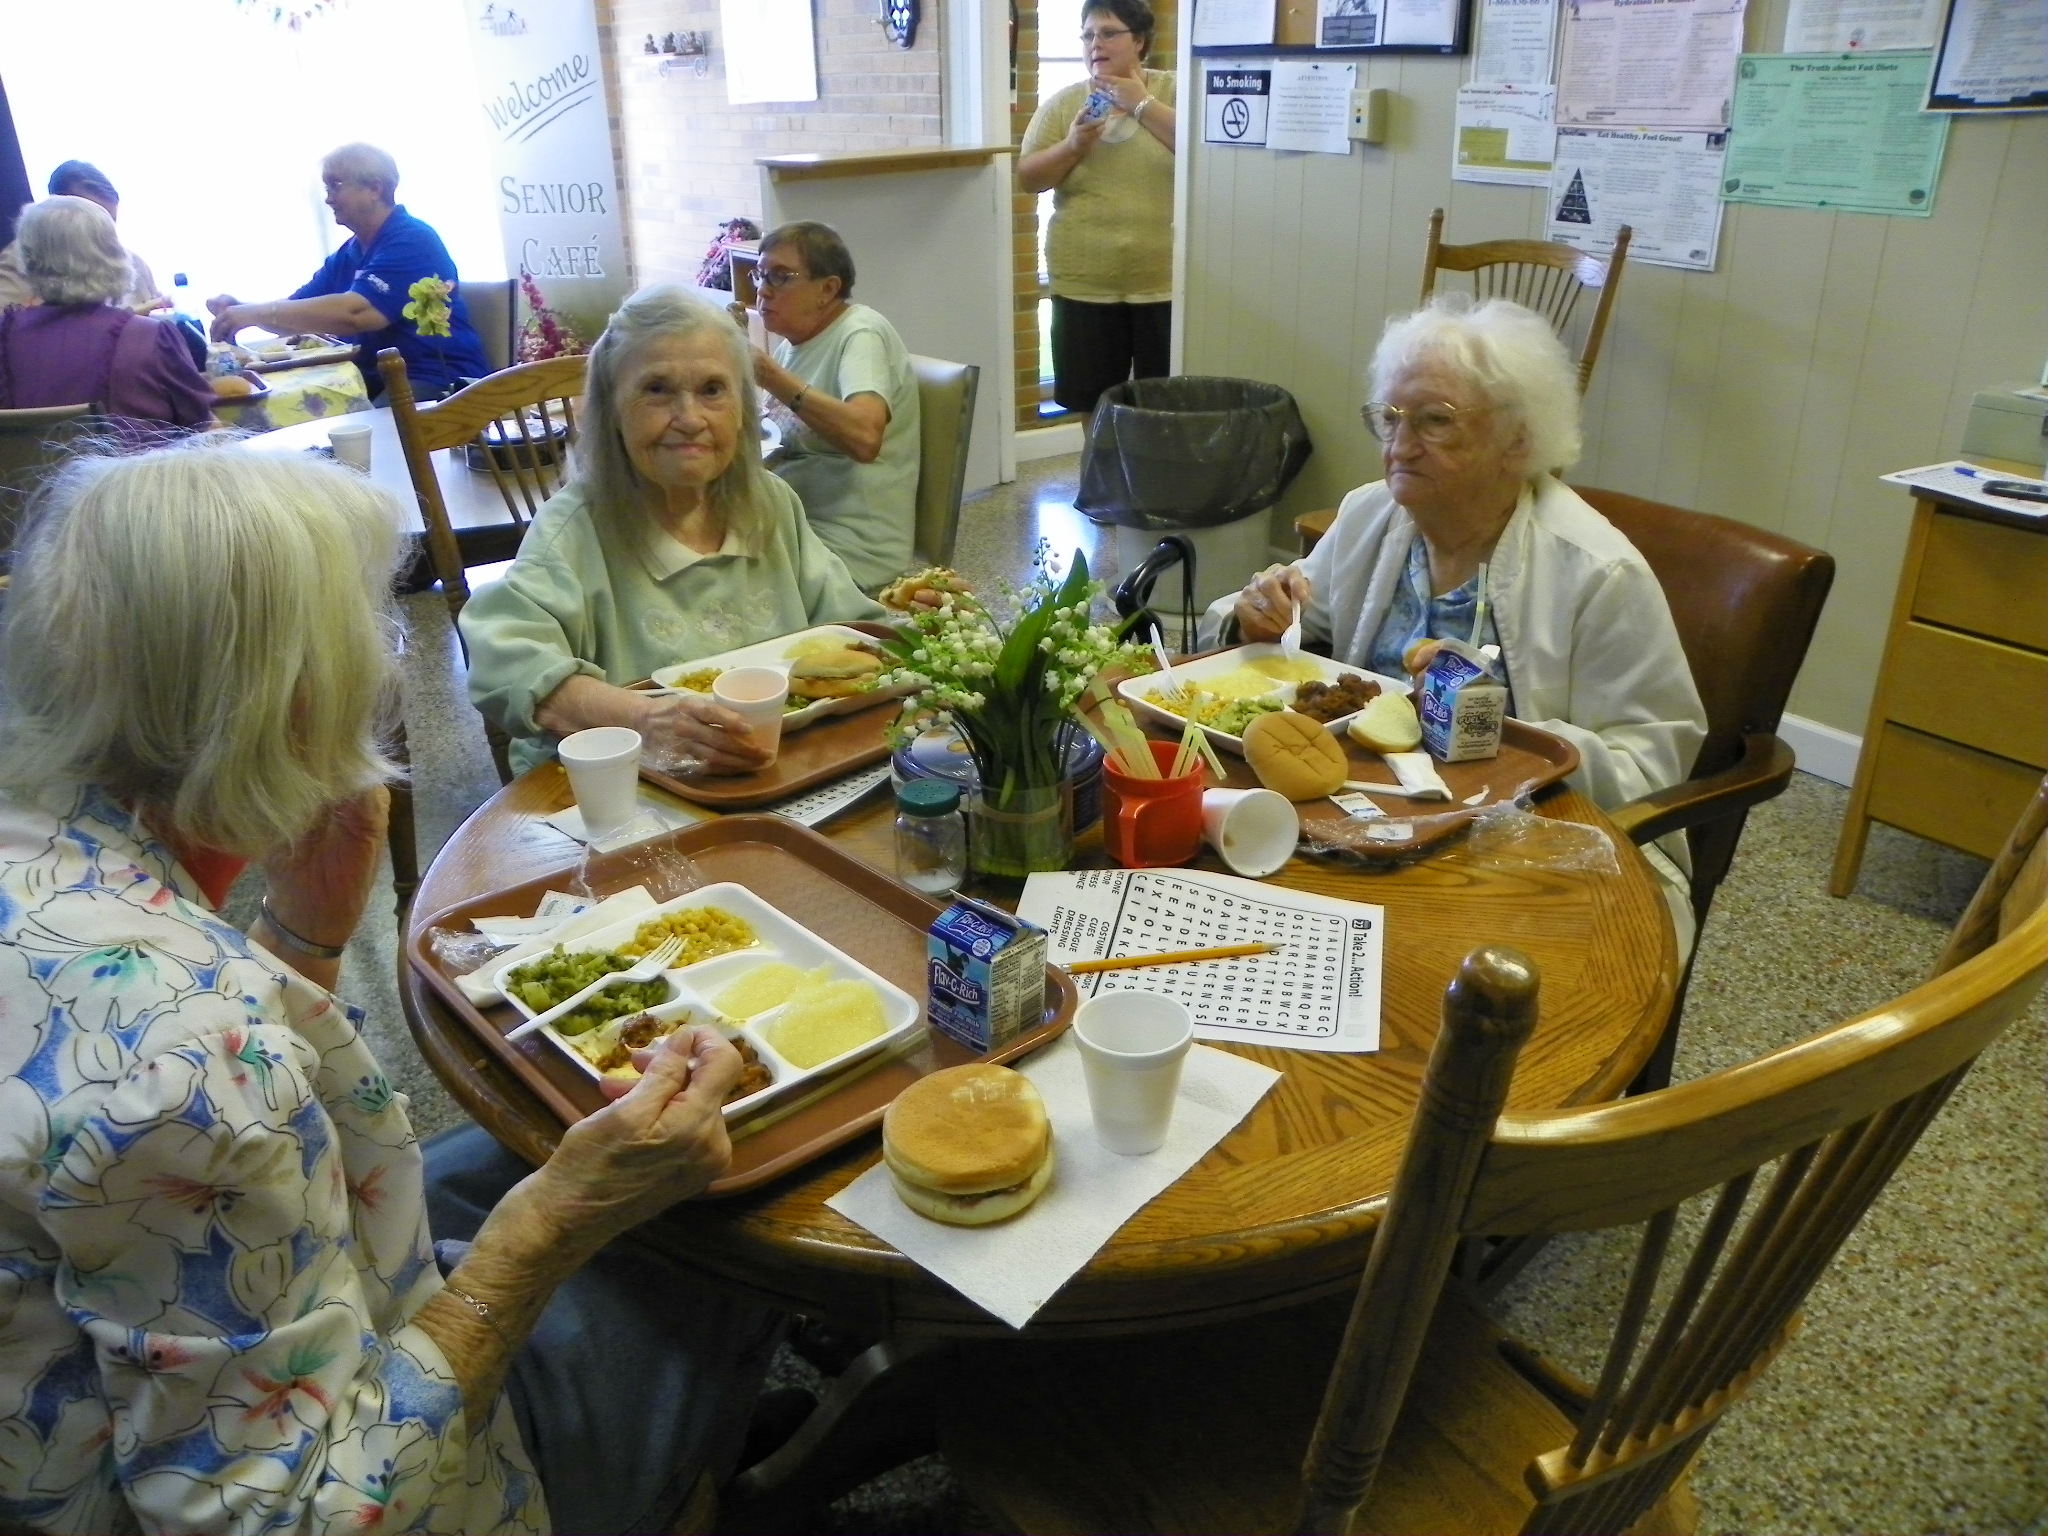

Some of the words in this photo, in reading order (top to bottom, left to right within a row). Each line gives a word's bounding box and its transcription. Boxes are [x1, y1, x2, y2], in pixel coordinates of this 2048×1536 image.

[1807, 64, 1831, 72] Truth
[481, 53, 589, 131] Welcome
[1213, 75, 1225, 88] No
[1226, 76, 1263, 92] Smoking
[1112, 880, 1122, 895] ONE
[1050, 905, 1064, 934] LIGHTS
[1058, 909, 1075, 948] DRESSING
[1069, 914, 1087, 952] DIALOGUE
[1087, 917, 1098, 937] CUES
[1094, 921, 1110, 955] COSTUME
[1353, 933, 1367, 951] Take
[1349, 966, 1365, 997] Action!
